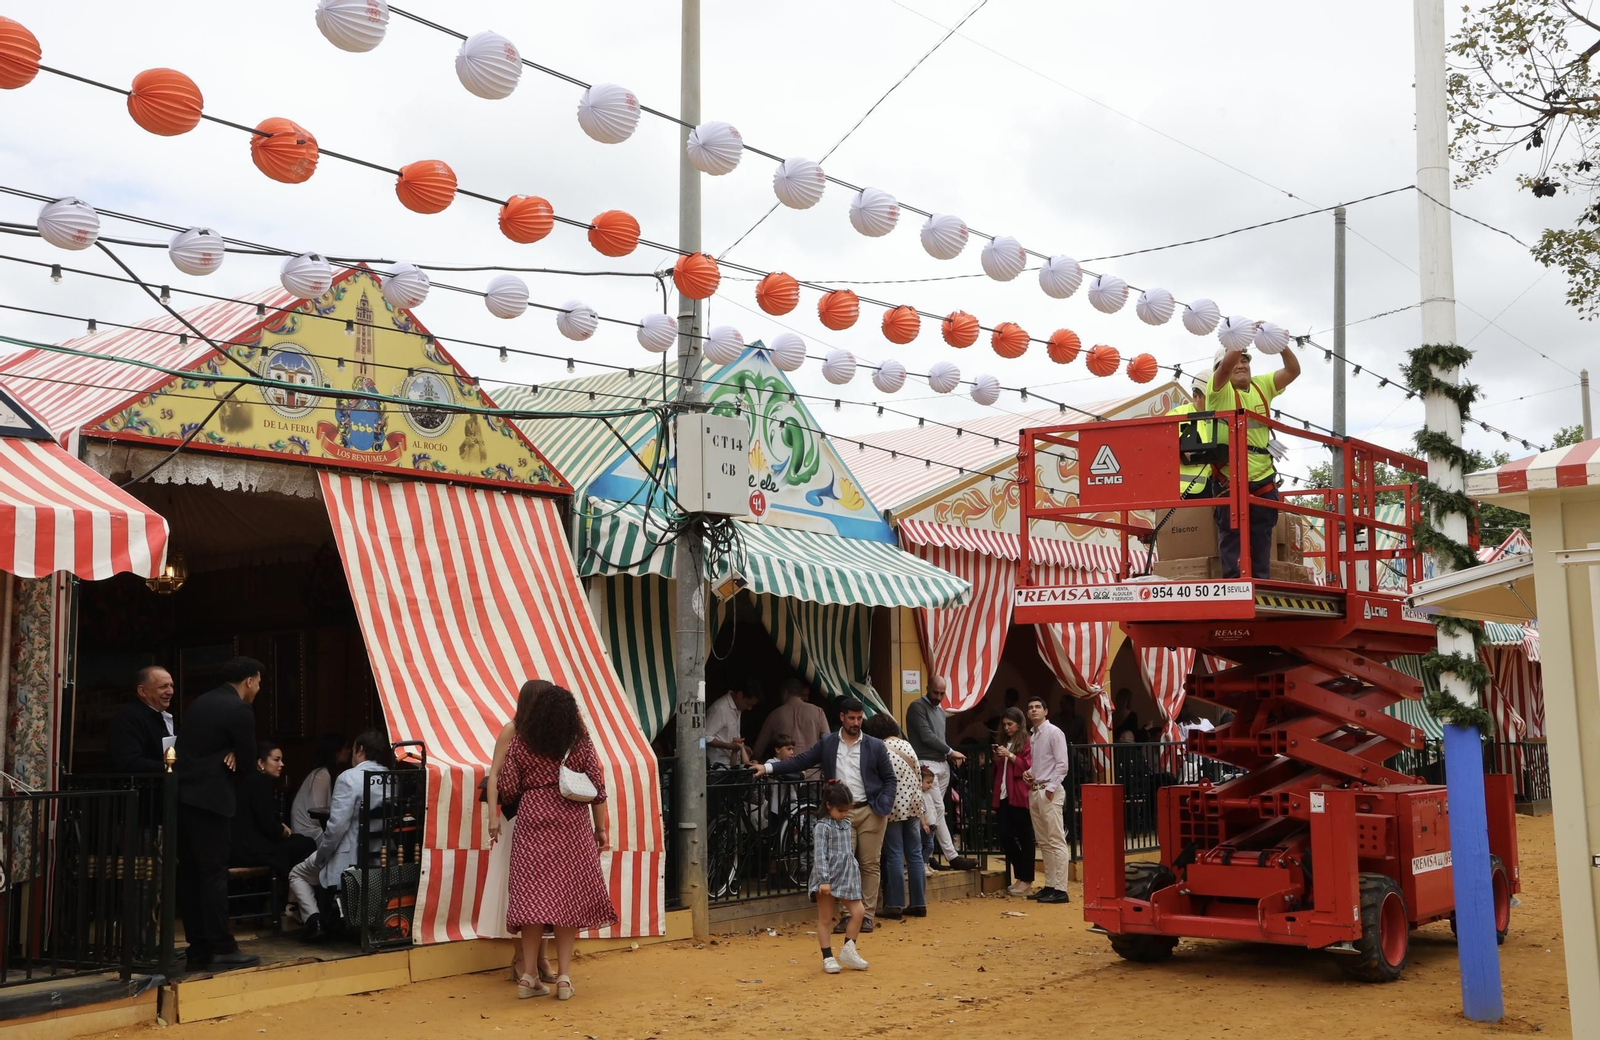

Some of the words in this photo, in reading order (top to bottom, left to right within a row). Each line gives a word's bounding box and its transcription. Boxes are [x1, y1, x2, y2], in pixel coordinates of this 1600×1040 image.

[160, 408, 174, 420] 39
[263, 419, 276, 429] DE
[278, 421, 289, 430] LA
[291, 422, 315, 434] FERIA
[412, 440, 423, 449] AL
[423, 441, 448, 453] ROCÍO
[336, 448, 351, 459] LOS
[351, 452, 388, 464] BENJUMEA
[517, 457, 528, 468] 39
[1087, 475, 1123, 486] LCMG
[1171, 525, 1199, 535] Elecnor
[1024, 588, 1092, 603] REMSA
[1152, 586, 1173, 599] 954
[1177, 585, 1191, 597] 40
[1195, 585, 1209, 597] 50
[1213, 584, 1227, 596] 21
[1227, 585, 1250, 593] SEVILLA
[1370, 605, 1388, 618] LCMG
[1214, 629, 1250, 637] REMSA
[1414, 855, 1438, 871] REMSA
